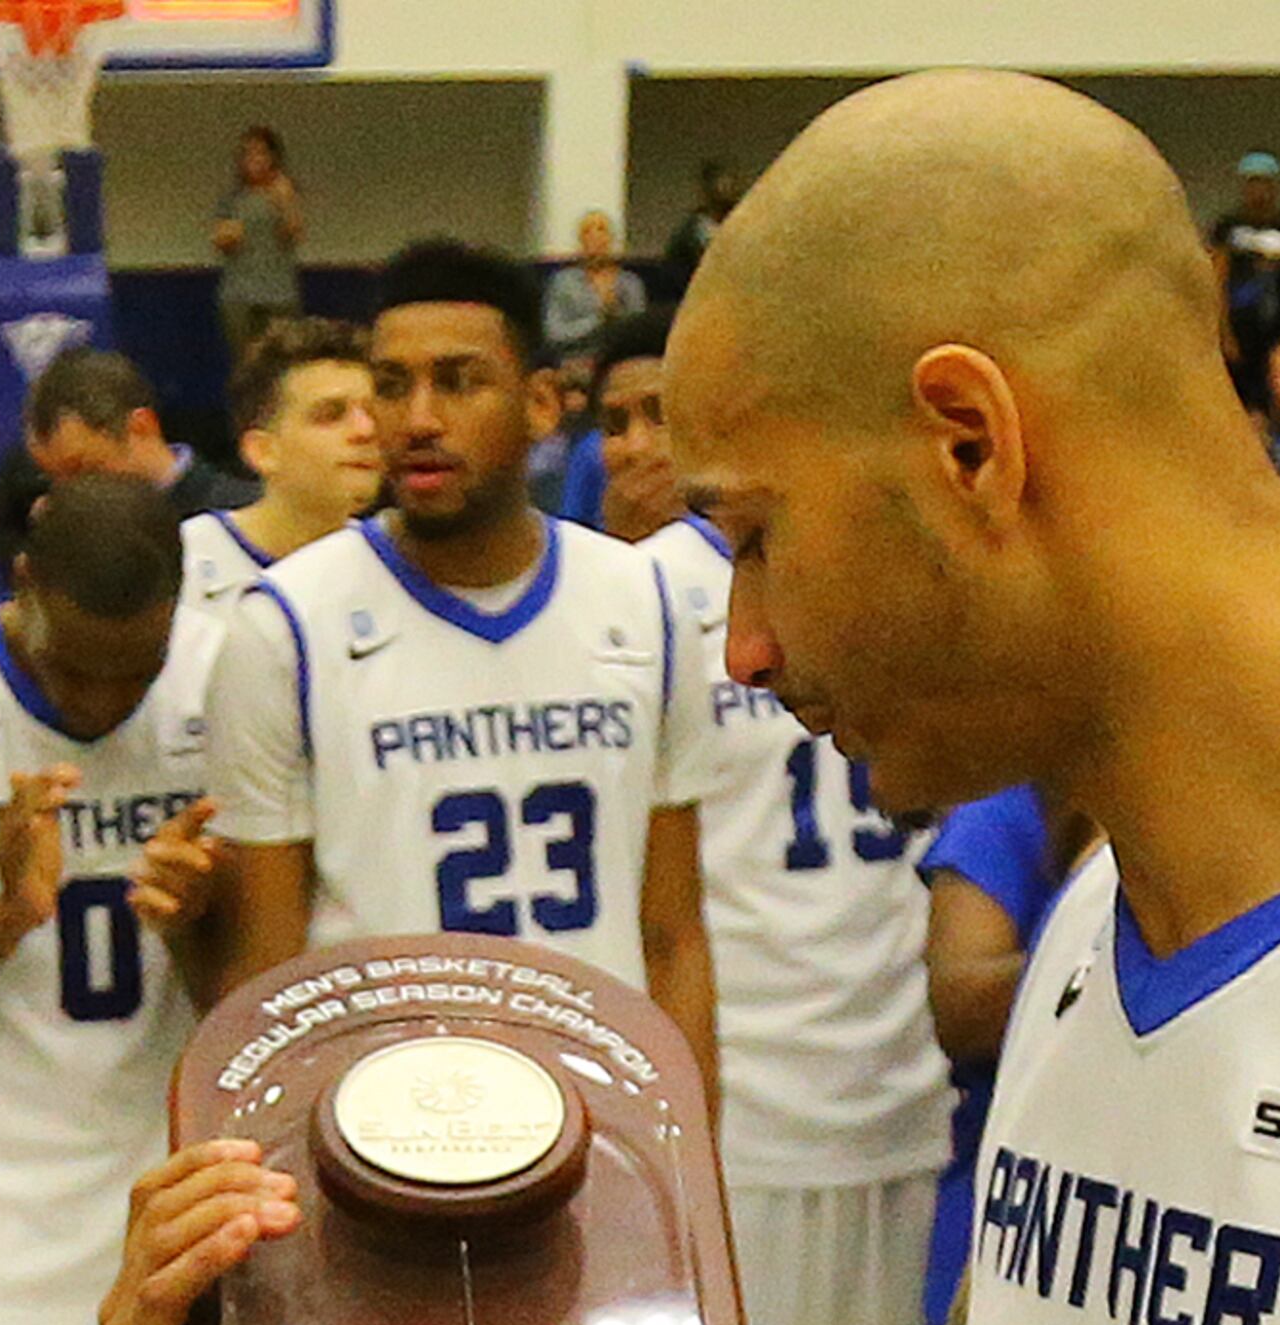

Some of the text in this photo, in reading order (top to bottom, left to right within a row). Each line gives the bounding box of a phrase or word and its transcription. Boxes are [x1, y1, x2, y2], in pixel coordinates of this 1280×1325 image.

[371, 699, 633, 769] PANTHERS
[431, 779, 598, 937] 23
[58, 876, 143, 1022] 0
[365, 956, 596, 1012] BASKETBALL
[217, 984, 661, 1090] REGULAR SEASON CHAMPION
